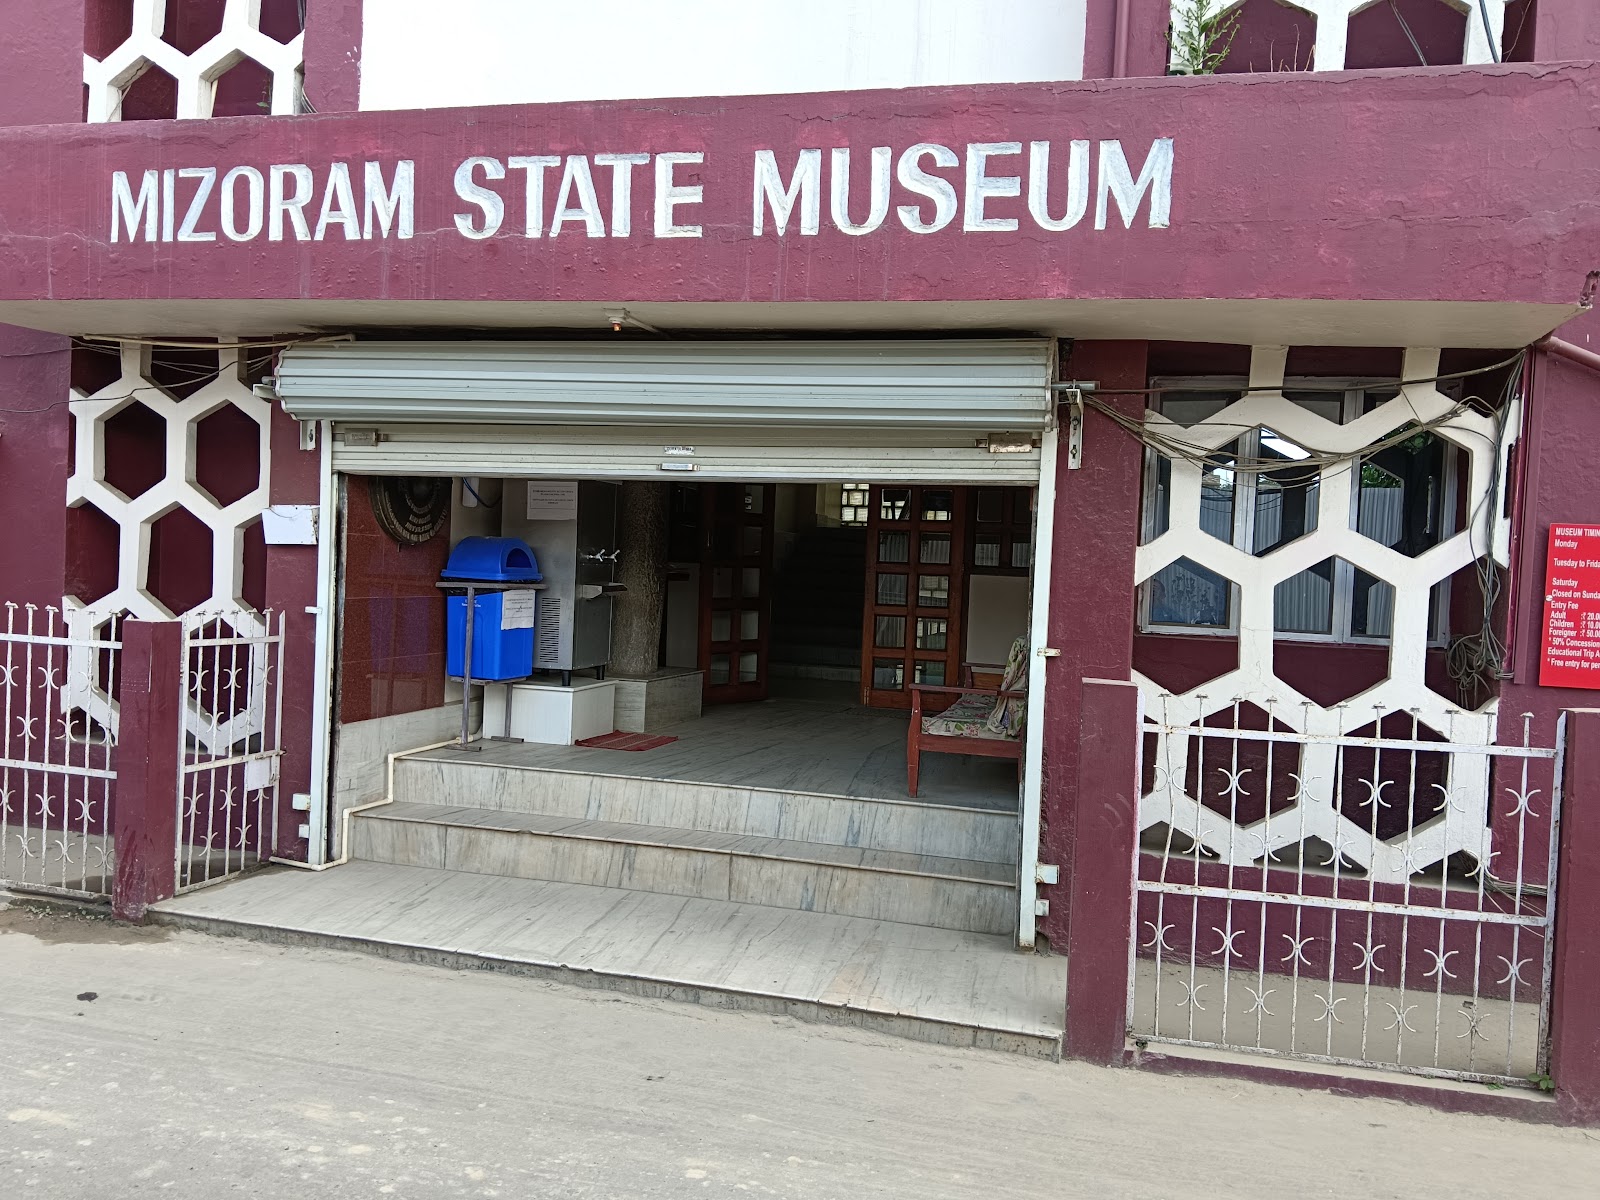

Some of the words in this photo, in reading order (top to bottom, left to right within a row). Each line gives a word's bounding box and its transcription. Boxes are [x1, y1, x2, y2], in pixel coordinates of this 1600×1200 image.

[109, 158, 415, 243] MIZORAM
[452, 150, 705, 241] STATE
[752, 137, 1176, 237] MUSEUM
[1555, 527, 1583, 537] MUSEUM
[1554, 539, 1578, 549] Monday
[1553, 558, 1578, 569] Tuesday
[1552, 577, 1578, 588] Saturday
[1551, 589, 1572, 598] Closed
[1550, 601, 1567, 610] Entry
[1567, 601, 1579, 610] Fee
[1550, 610, 1566, 619] Adult
[1549, 619, 1574, 628] Children
[1548, 628, 1577, 638] Foreigner
[1547, 647, 1582, 657] Educational
[1583, 649, 1595, 659] Trip
[1550, 658, 1564, 667] Free
[1564, 659, 1580, 669] entry
[1581, 659, 1590, 668] for
